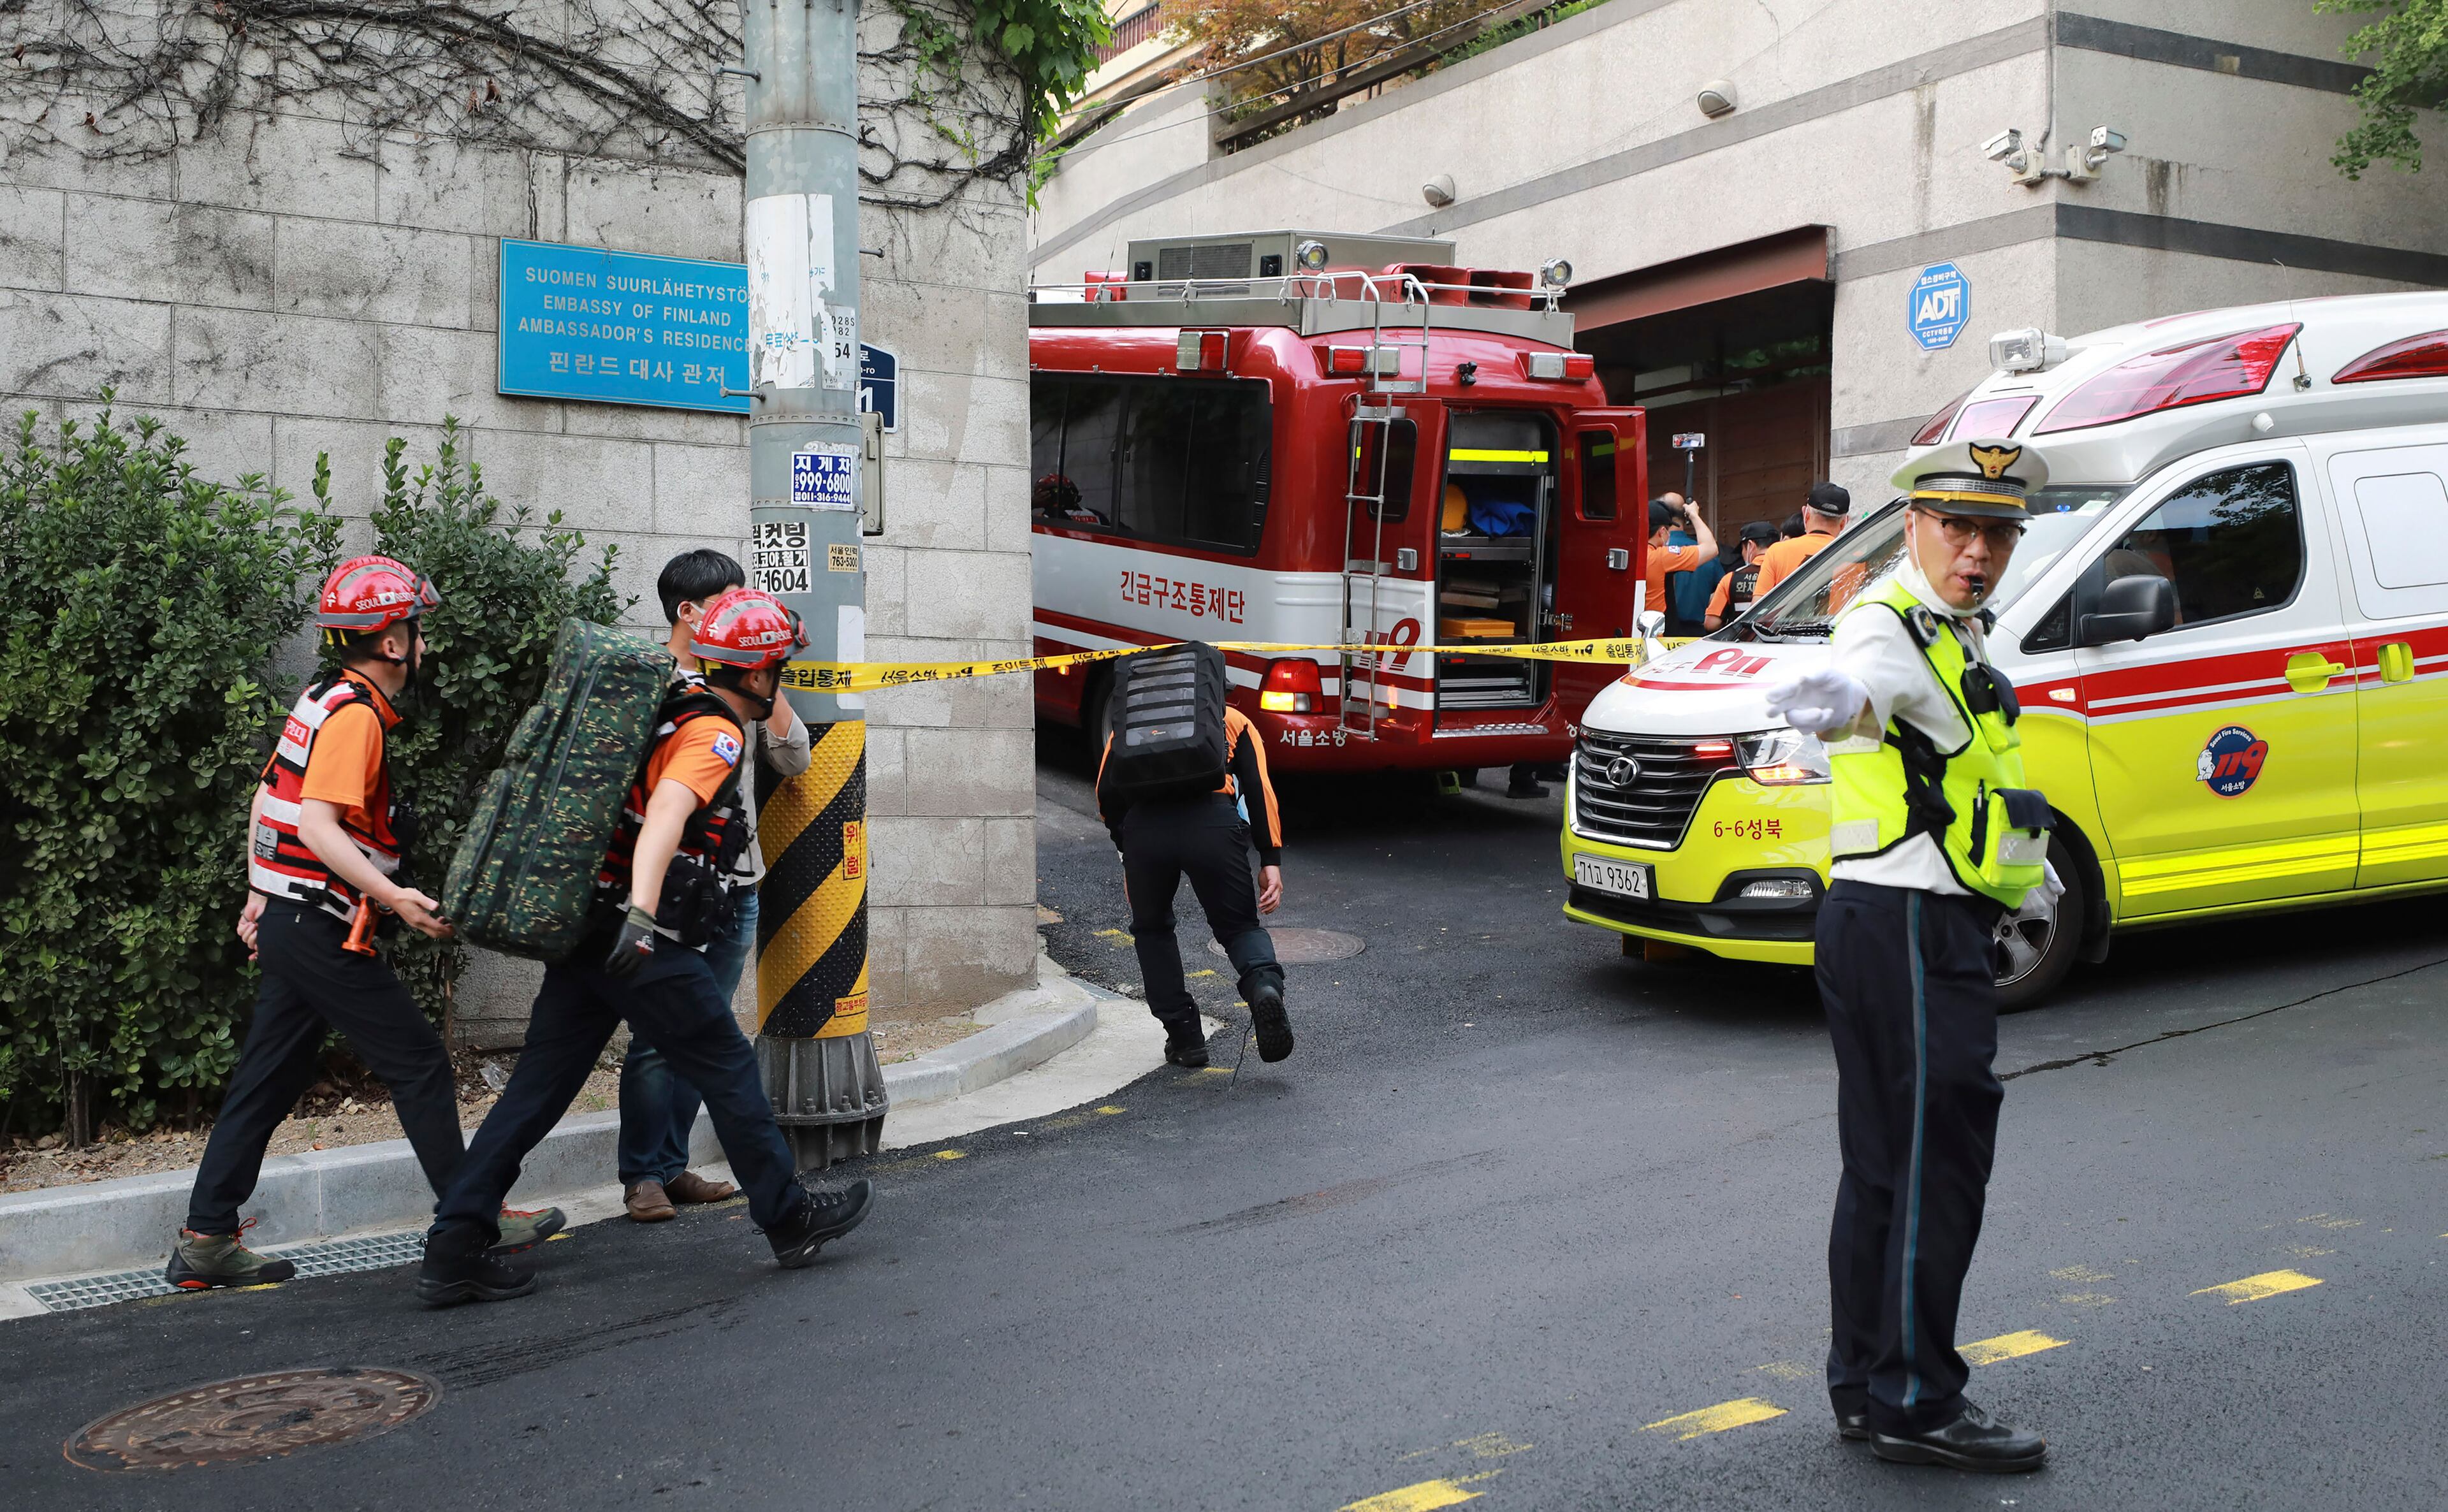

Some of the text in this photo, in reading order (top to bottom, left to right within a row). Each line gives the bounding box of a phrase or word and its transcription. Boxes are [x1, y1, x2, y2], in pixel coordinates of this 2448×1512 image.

[525, 266, 748, 303] SUOMEN SUURLÄHETYSTÖ
[544, 294, 731, 326] EMBASSY OF FINLAND
[1917, 287, 1960, 324] ADT
[518, 317, 749, 352] AMBASSADOR'S RESIDENCE
[549, 352, 725, 386] 핀란드 대사 관저
[355, 595, 381, 611] SEOUL
[1121, 571, 1245, 624] 긴급구조통제단
[738, 634, 762, 647] SEOUL
[1359, 617, 1420, 671] 119
[1280, 729, 1348, 747] 서울소방
[2212, 740, 2268, 779] 119
[1714, 819, 1782, 840] 6-6성북
[1606, 866, 1640, 893] 9362
